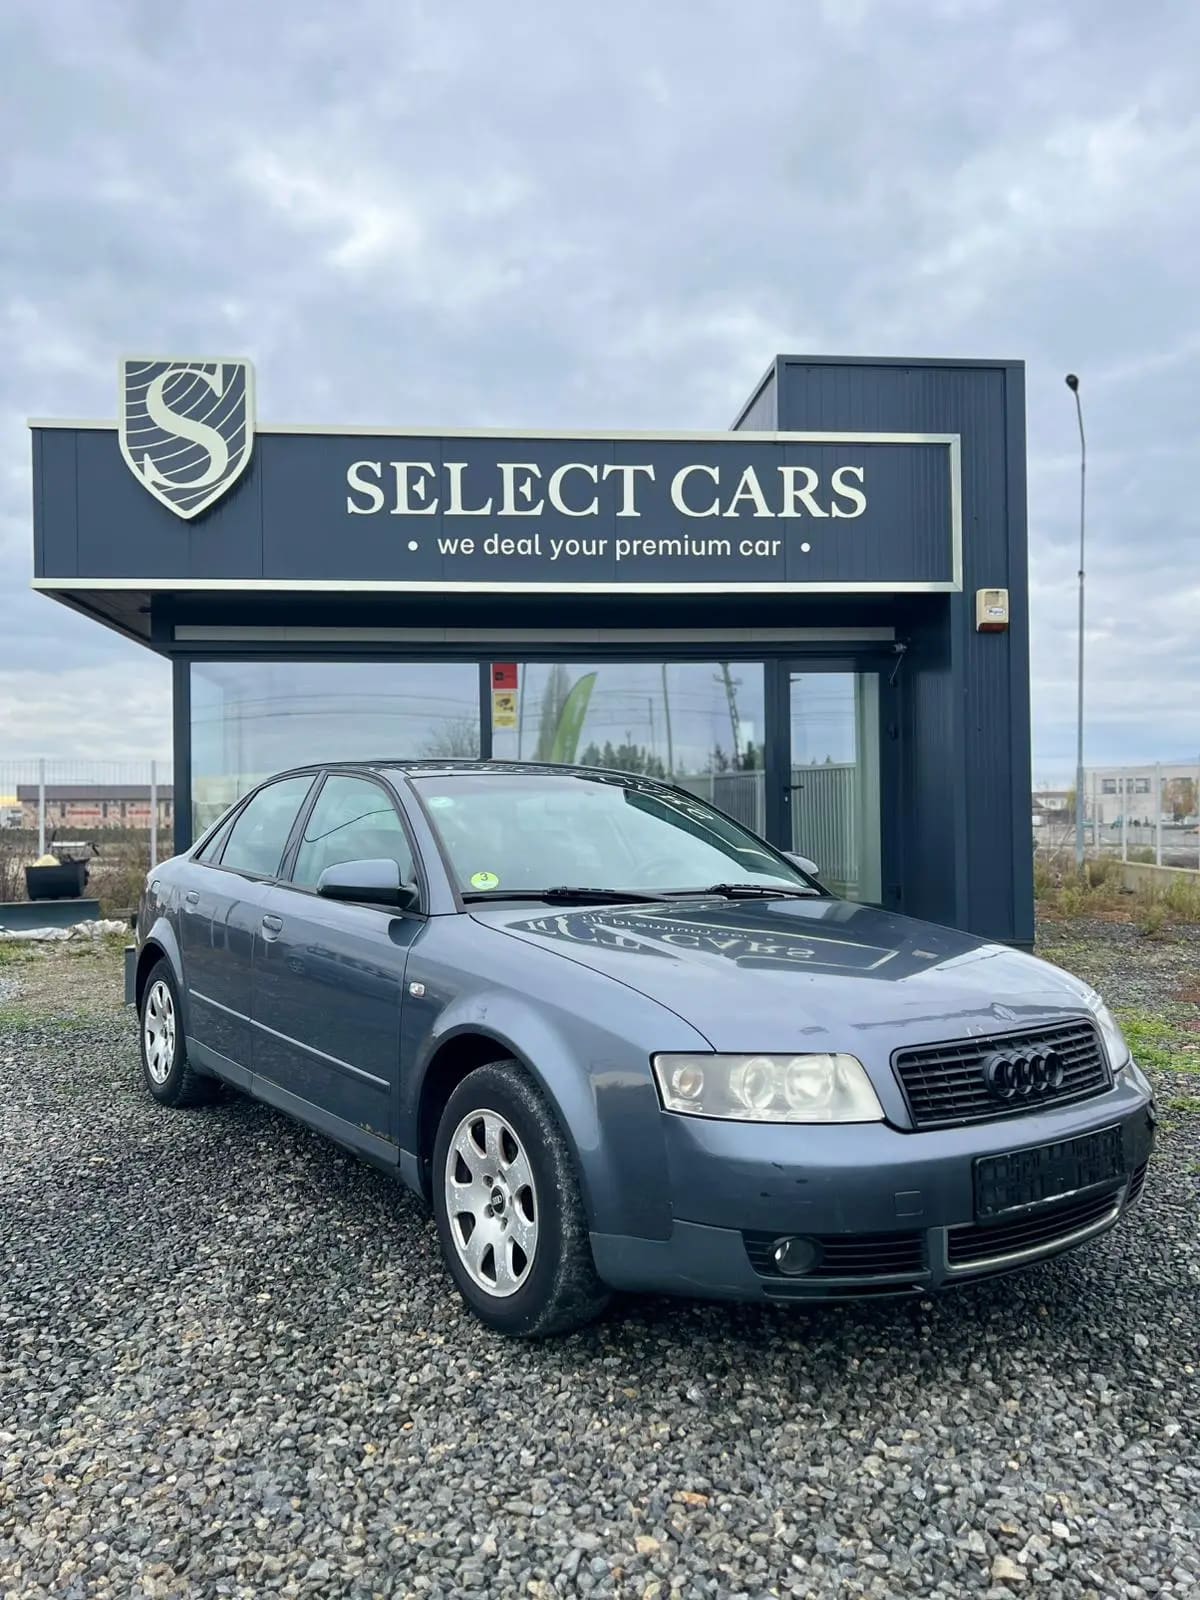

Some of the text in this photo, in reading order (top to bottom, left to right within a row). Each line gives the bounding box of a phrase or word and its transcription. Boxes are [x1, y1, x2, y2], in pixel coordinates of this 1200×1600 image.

[144, 364, 229, 488] S
[347, 461, 867, 519] SELECT CARS
[438, 533, 782, 561] we deal your premium car
[480, 872, 489, 881] 3
